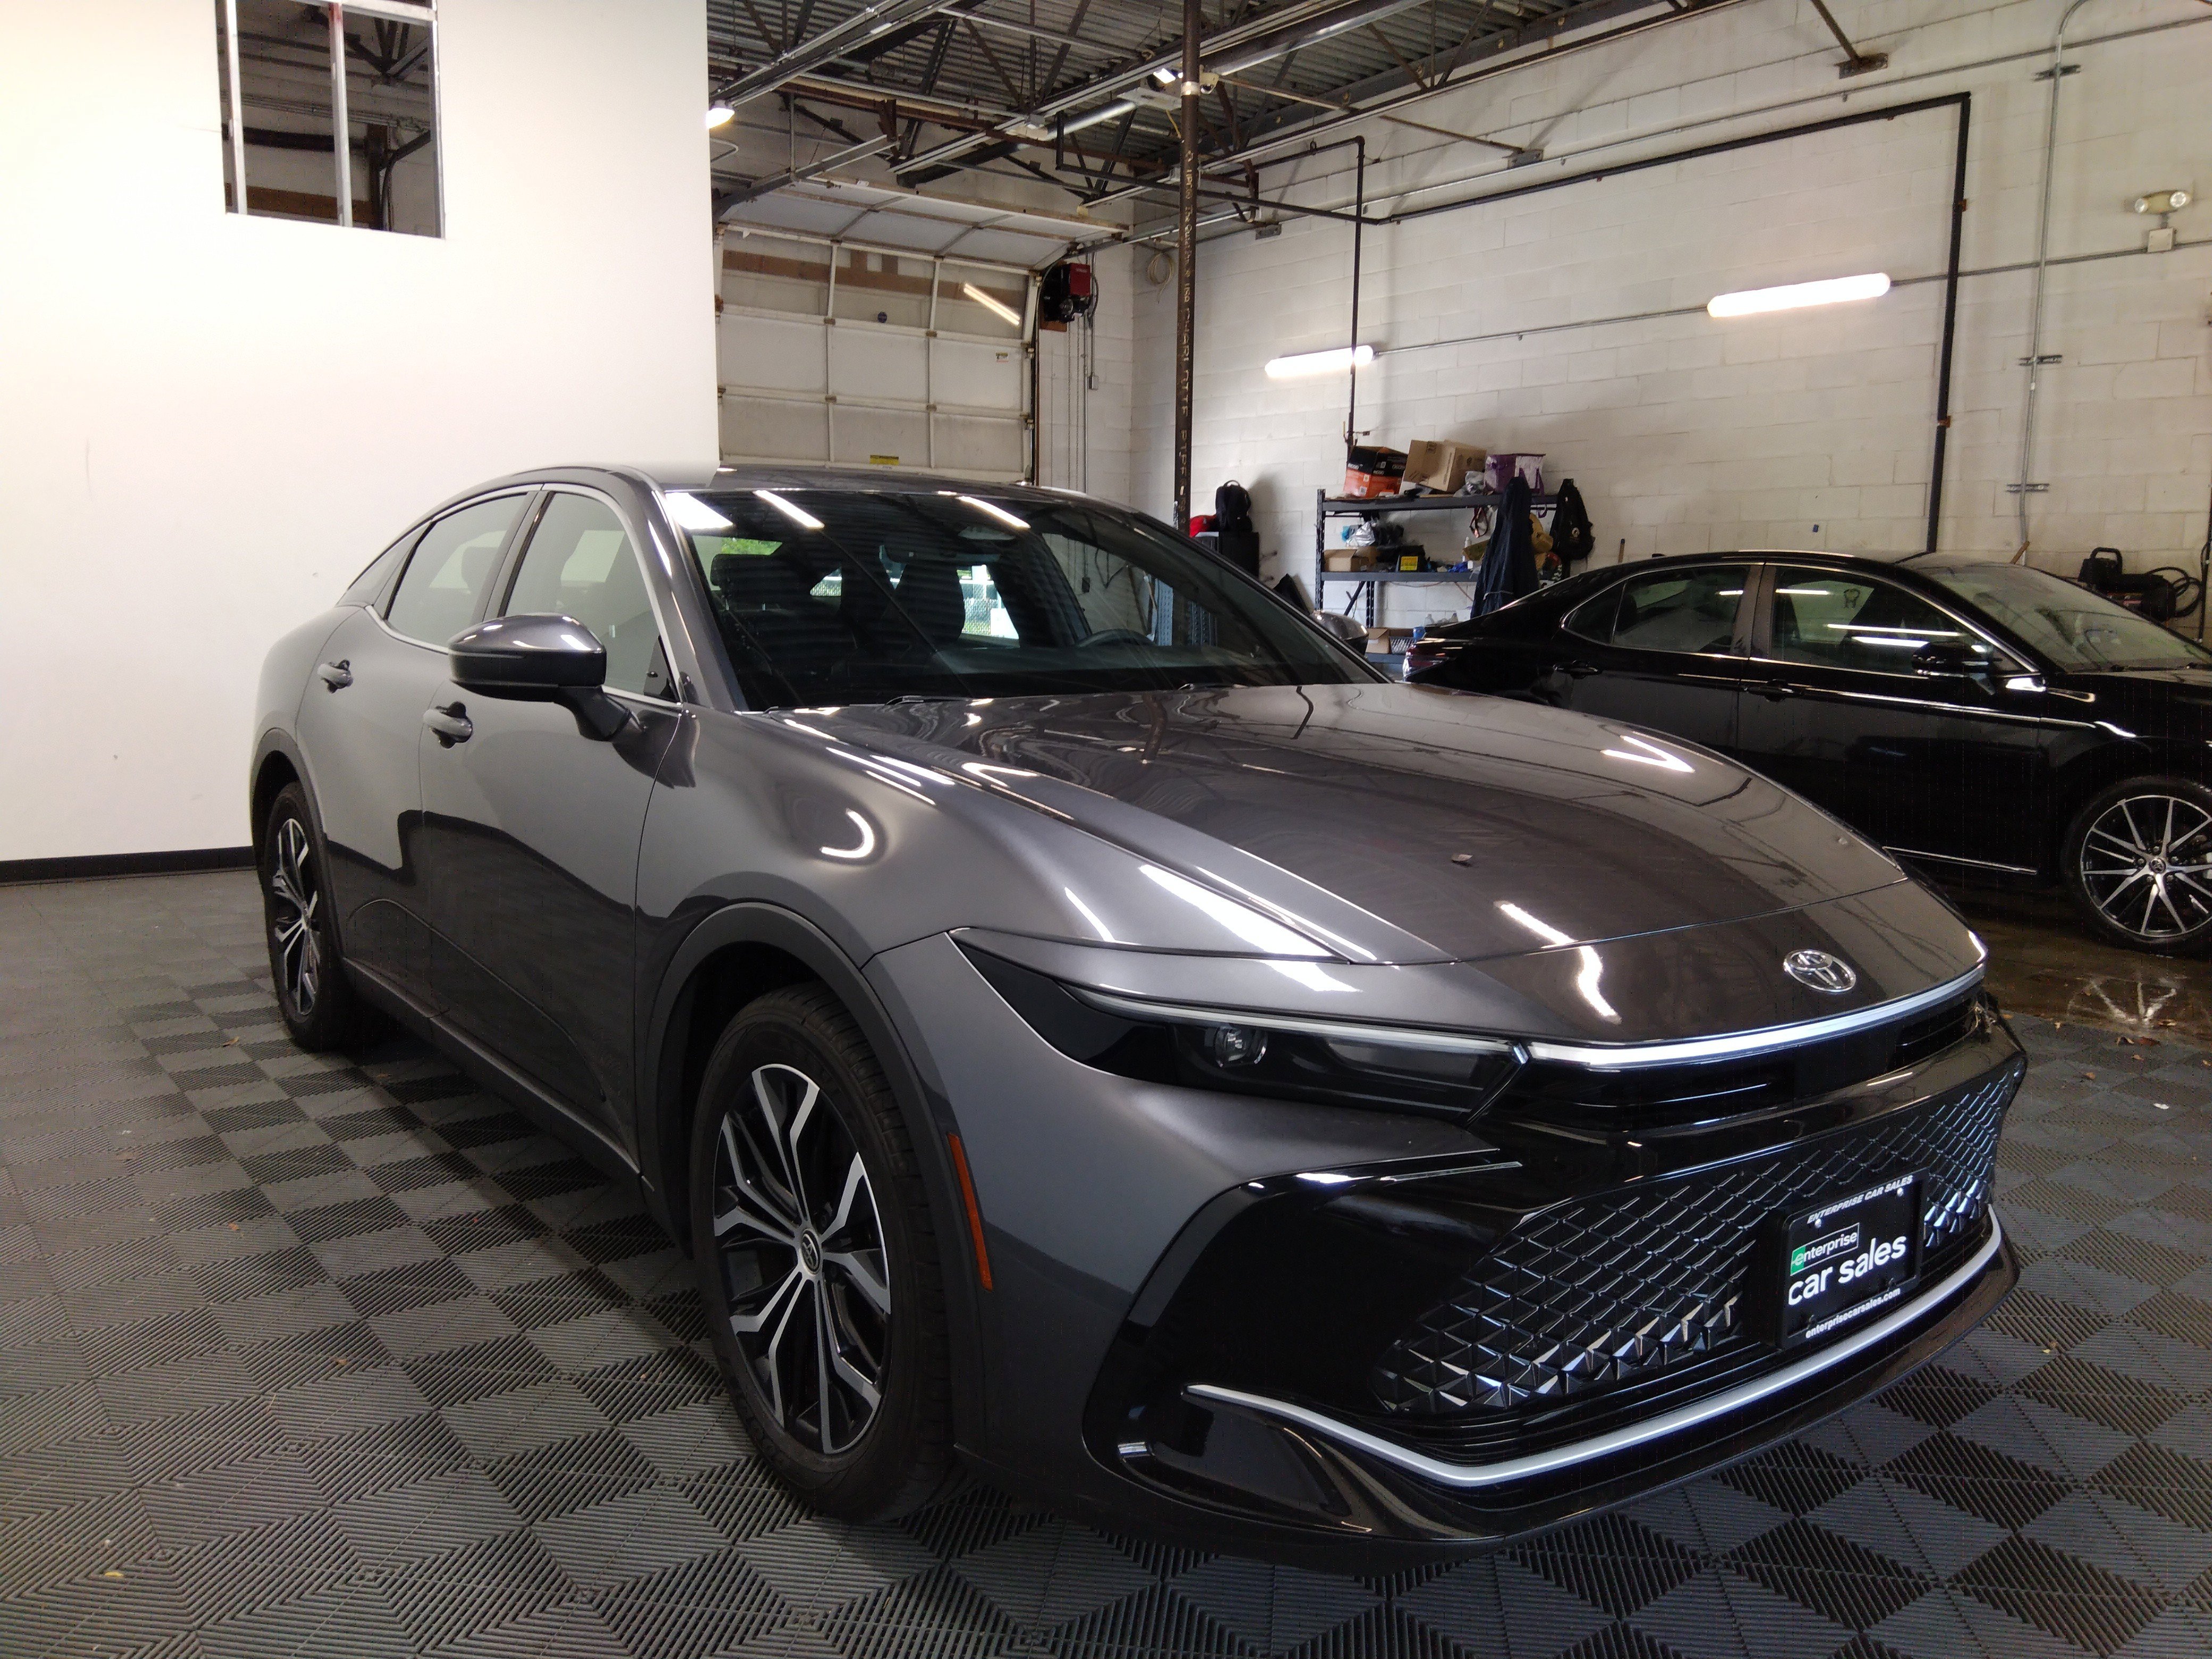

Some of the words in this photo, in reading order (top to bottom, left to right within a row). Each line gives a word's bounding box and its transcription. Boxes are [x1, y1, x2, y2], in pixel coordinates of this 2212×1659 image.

[1807, 1194, 1864, 1224] ENTERPRISE
[1864, 1186, 1884, 1201] CAR
[1884, 1175, 1913, 1193] SALES
[1788, 1266, 1833, 1305] car
[1838, 1235, 1907, 1284] sales
[1792, 1231, 1857, 1266] enterprise
[1805, 1287, 1901, 1339] enterprisecarsales.com
